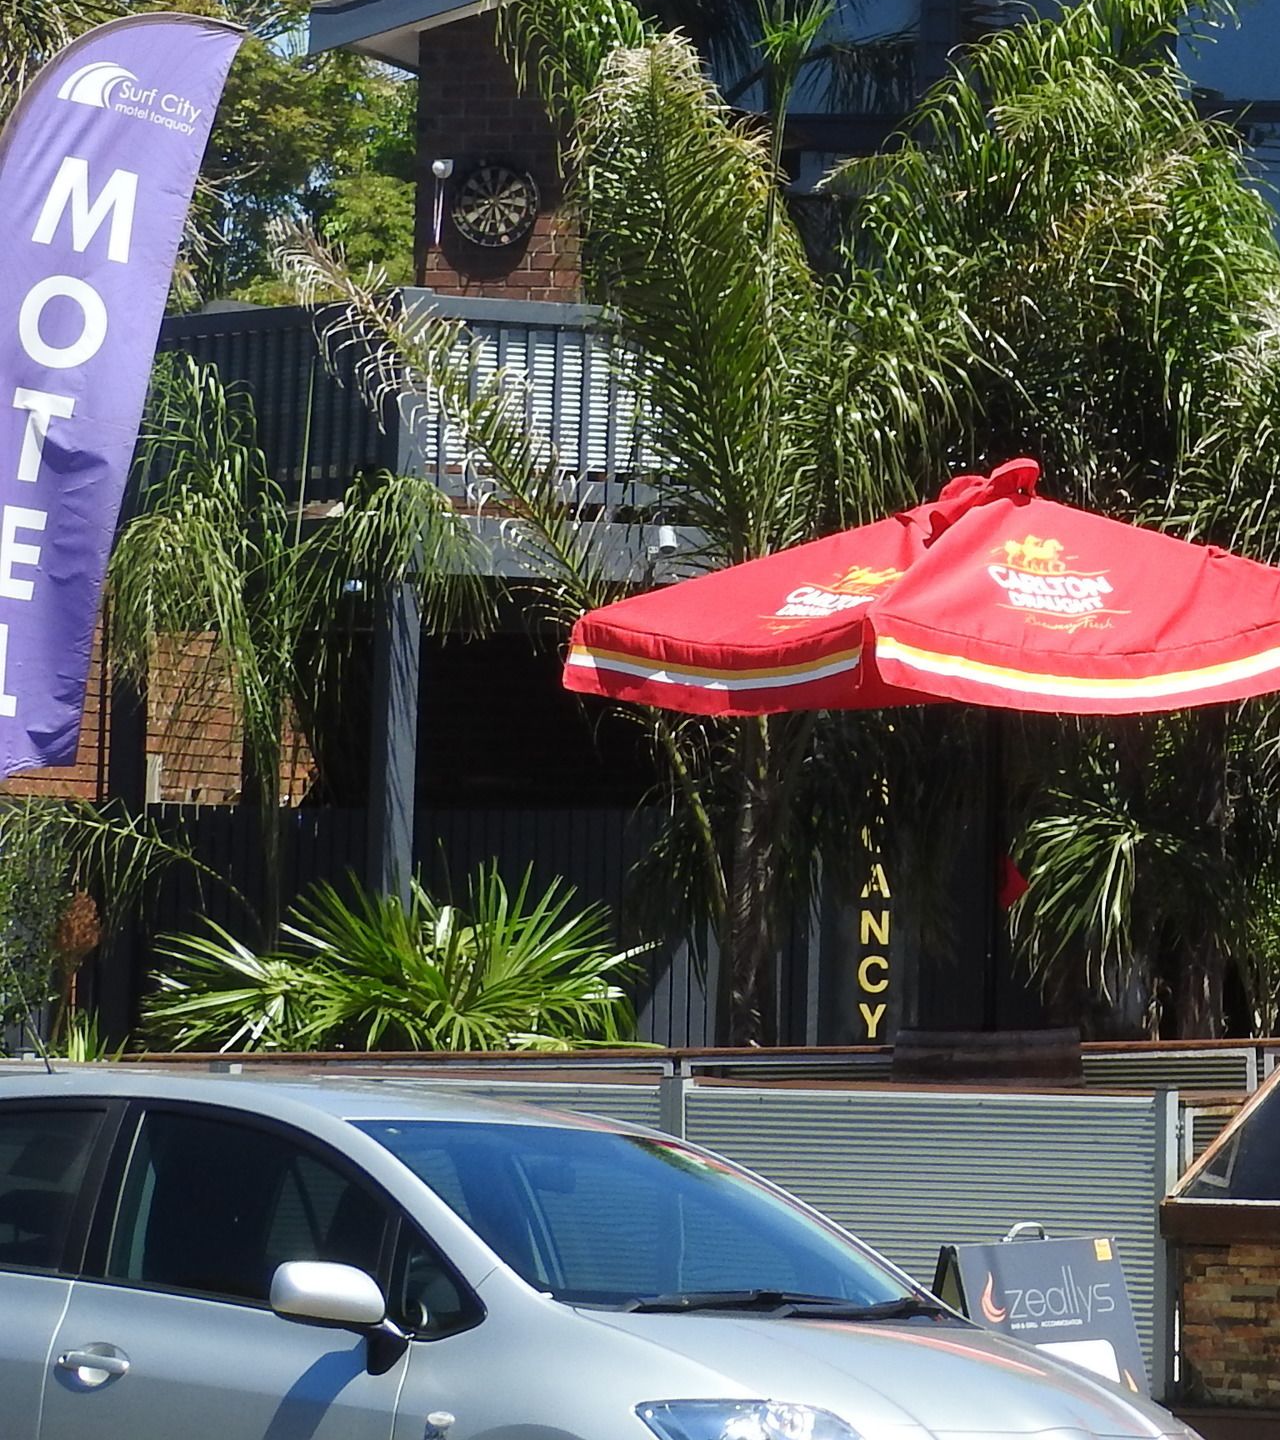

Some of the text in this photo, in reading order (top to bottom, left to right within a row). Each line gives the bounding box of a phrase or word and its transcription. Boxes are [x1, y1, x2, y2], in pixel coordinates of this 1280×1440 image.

[114, 103, 196, 136] motel torquay
[119, 81, 202, 123] Surf City
[988, 565, 1115, 599] CARLTON
[1004, 1265, 1115, 1321] zeallys
